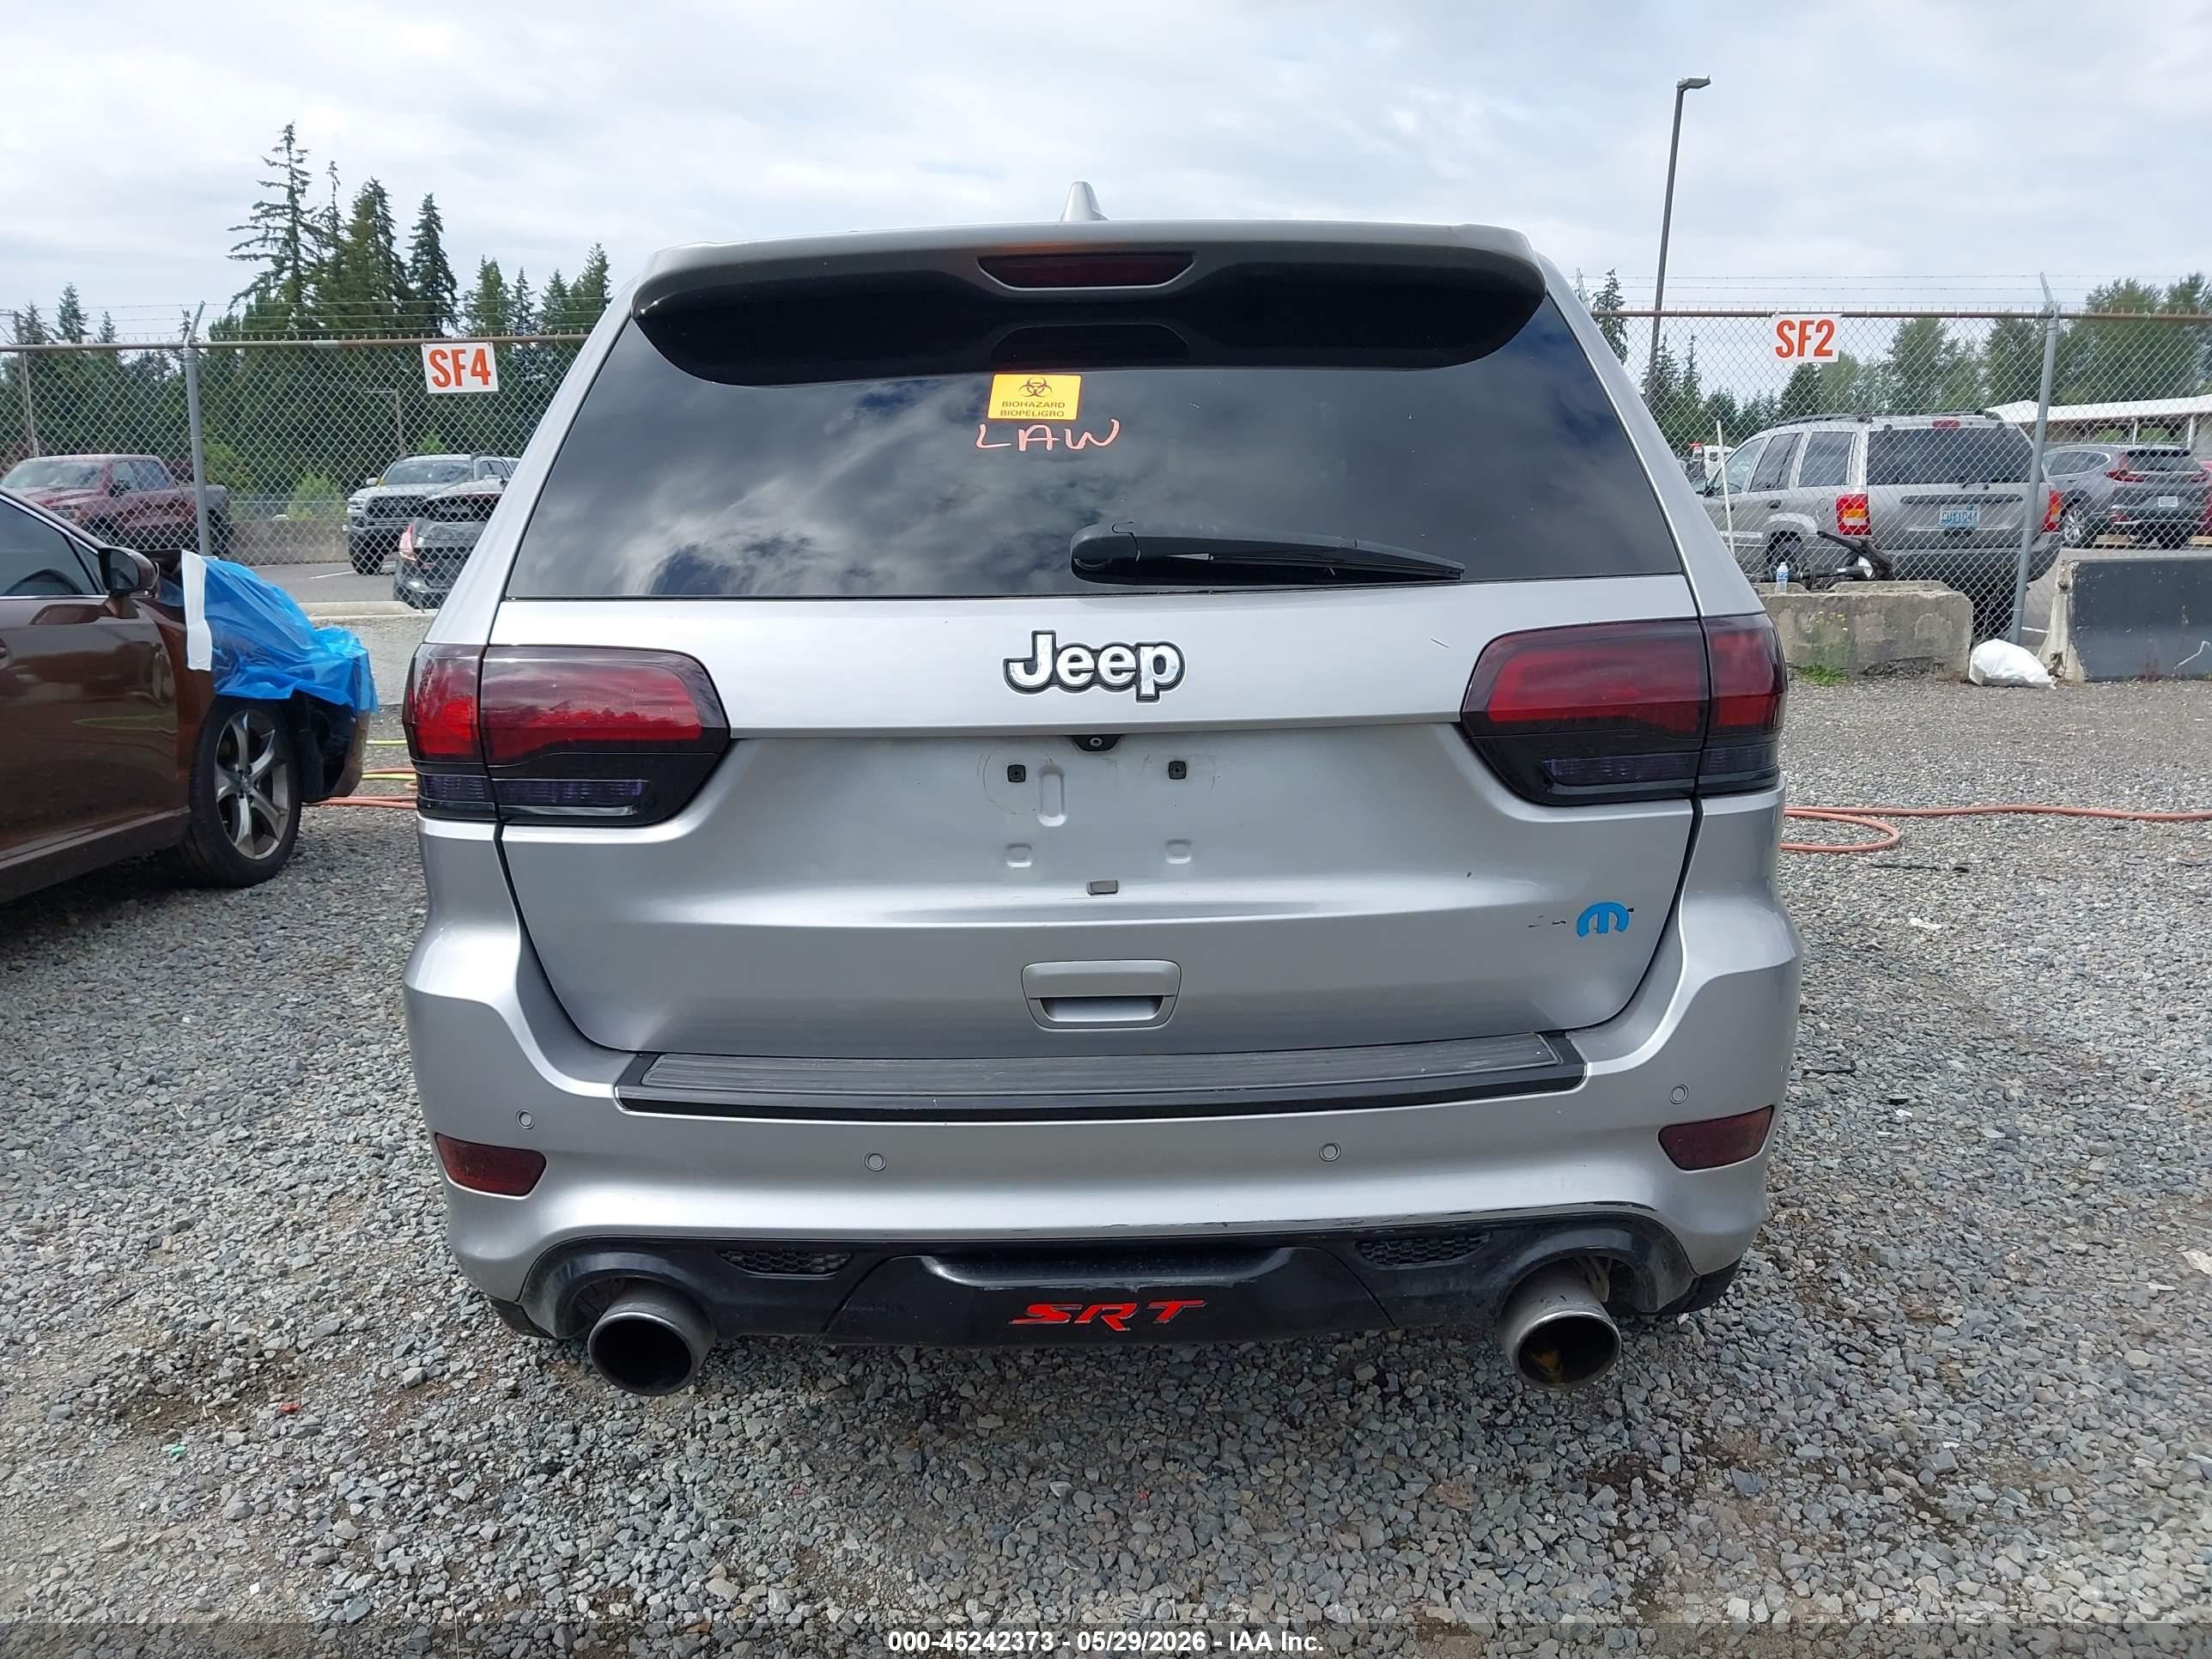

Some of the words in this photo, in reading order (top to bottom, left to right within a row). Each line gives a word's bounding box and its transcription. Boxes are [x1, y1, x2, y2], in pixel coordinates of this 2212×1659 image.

[1775, 319, 1835, 358] SF2
[428, 349, 491, 388] SF4
[975, 418, 1120, 452] LAW
[1005, 630, 1185, 702] Jeep
[1009, 1300, 1206, 1332] SRT
